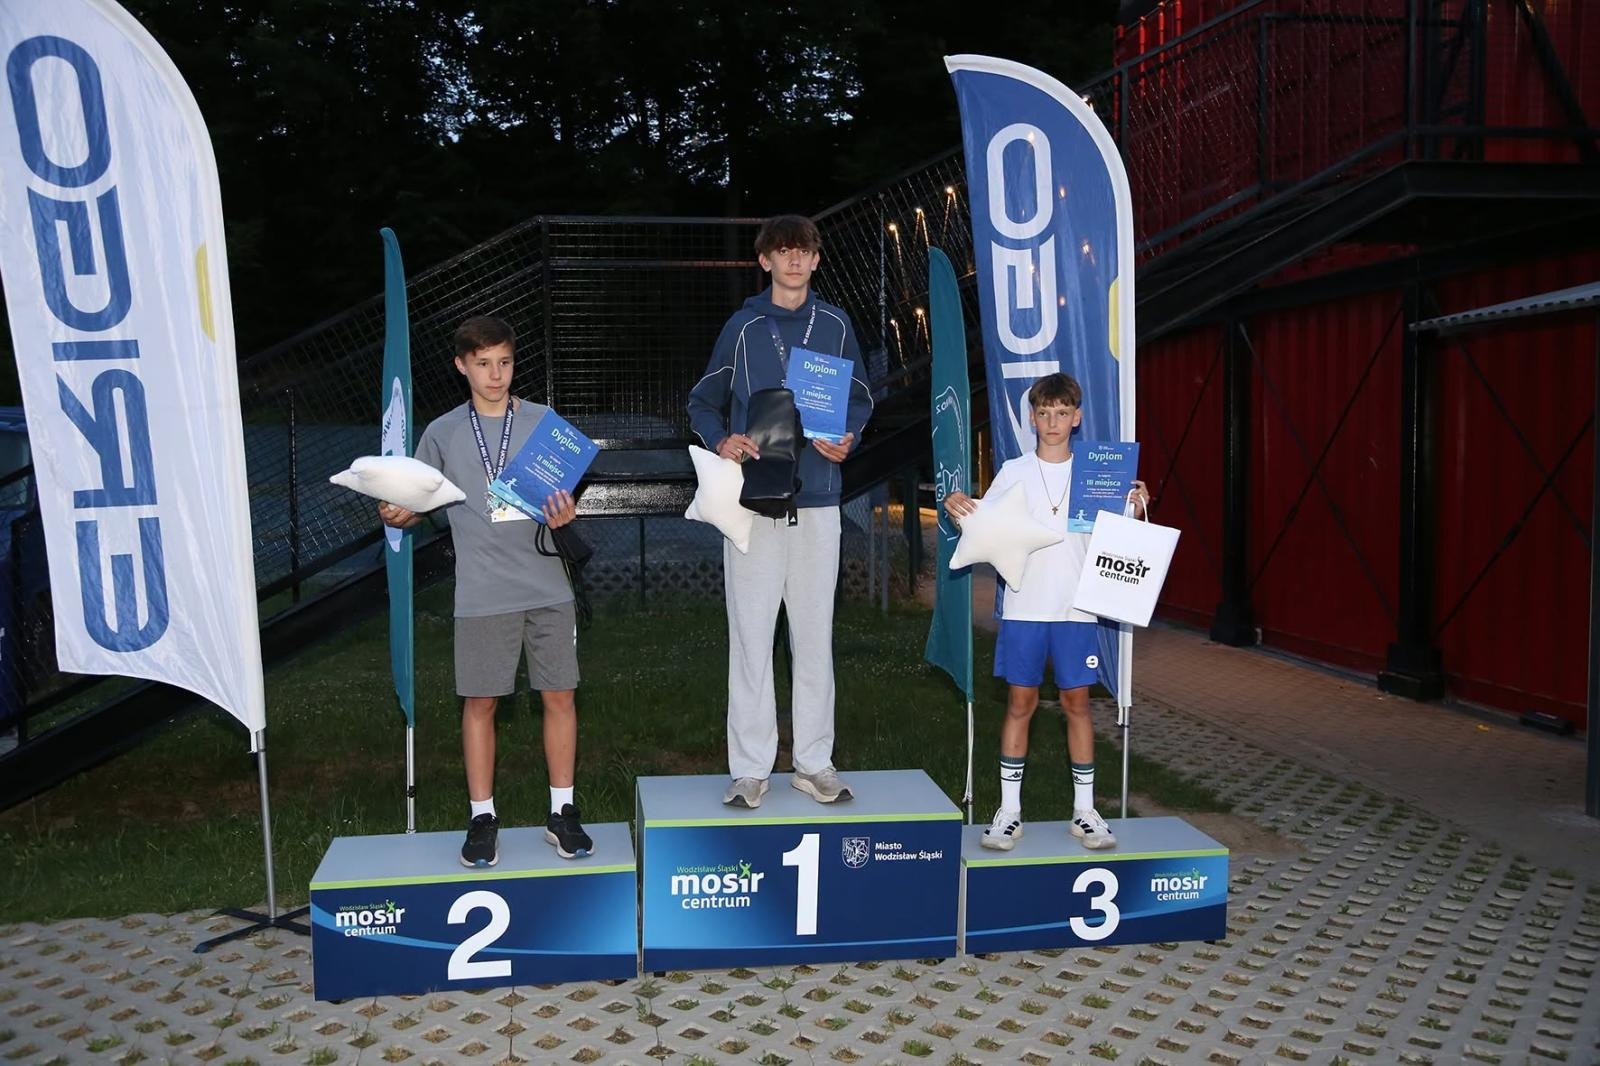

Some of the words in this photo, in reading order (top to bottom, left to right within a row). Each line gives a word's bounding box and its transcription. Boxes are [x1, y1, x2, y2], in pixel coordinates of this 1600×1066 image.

[803, 361, 838, 376] Dyplom
[806, 390, 832, 401] miejsca
[551, 428, 581, 455] Dyplom
[1088, 451, 1123, 462] Dyplom
[541, 458, 565, 478] miejsca
[1094, 479, 1121, 487] miejsca
[1096, 555, 1150, 578] mosir
[1100, 569, 1140, 585] centrum
[875, 841, 903, 850] Miasto
[874, 851, 918, 861] Wodzisław
[918, 849, 943, 862] Śląski
[676, 865, 716, 873] Wodzisław
[717, 863, 738, 873] Śląski
[671, 872, 765, 896] mosir
[782, 833, 820, 936] 1
[1151, 875, 1208, 892] mosir
[681, 895, 751, 909] centrum
[1157, 891, 1200, 901] centrum
[1069, 867, 1121, 941] 3
[335, 908, 406, 927] mosir
[344, 925, 397, 937] centrum
[447, 890, 512, 981] 2
